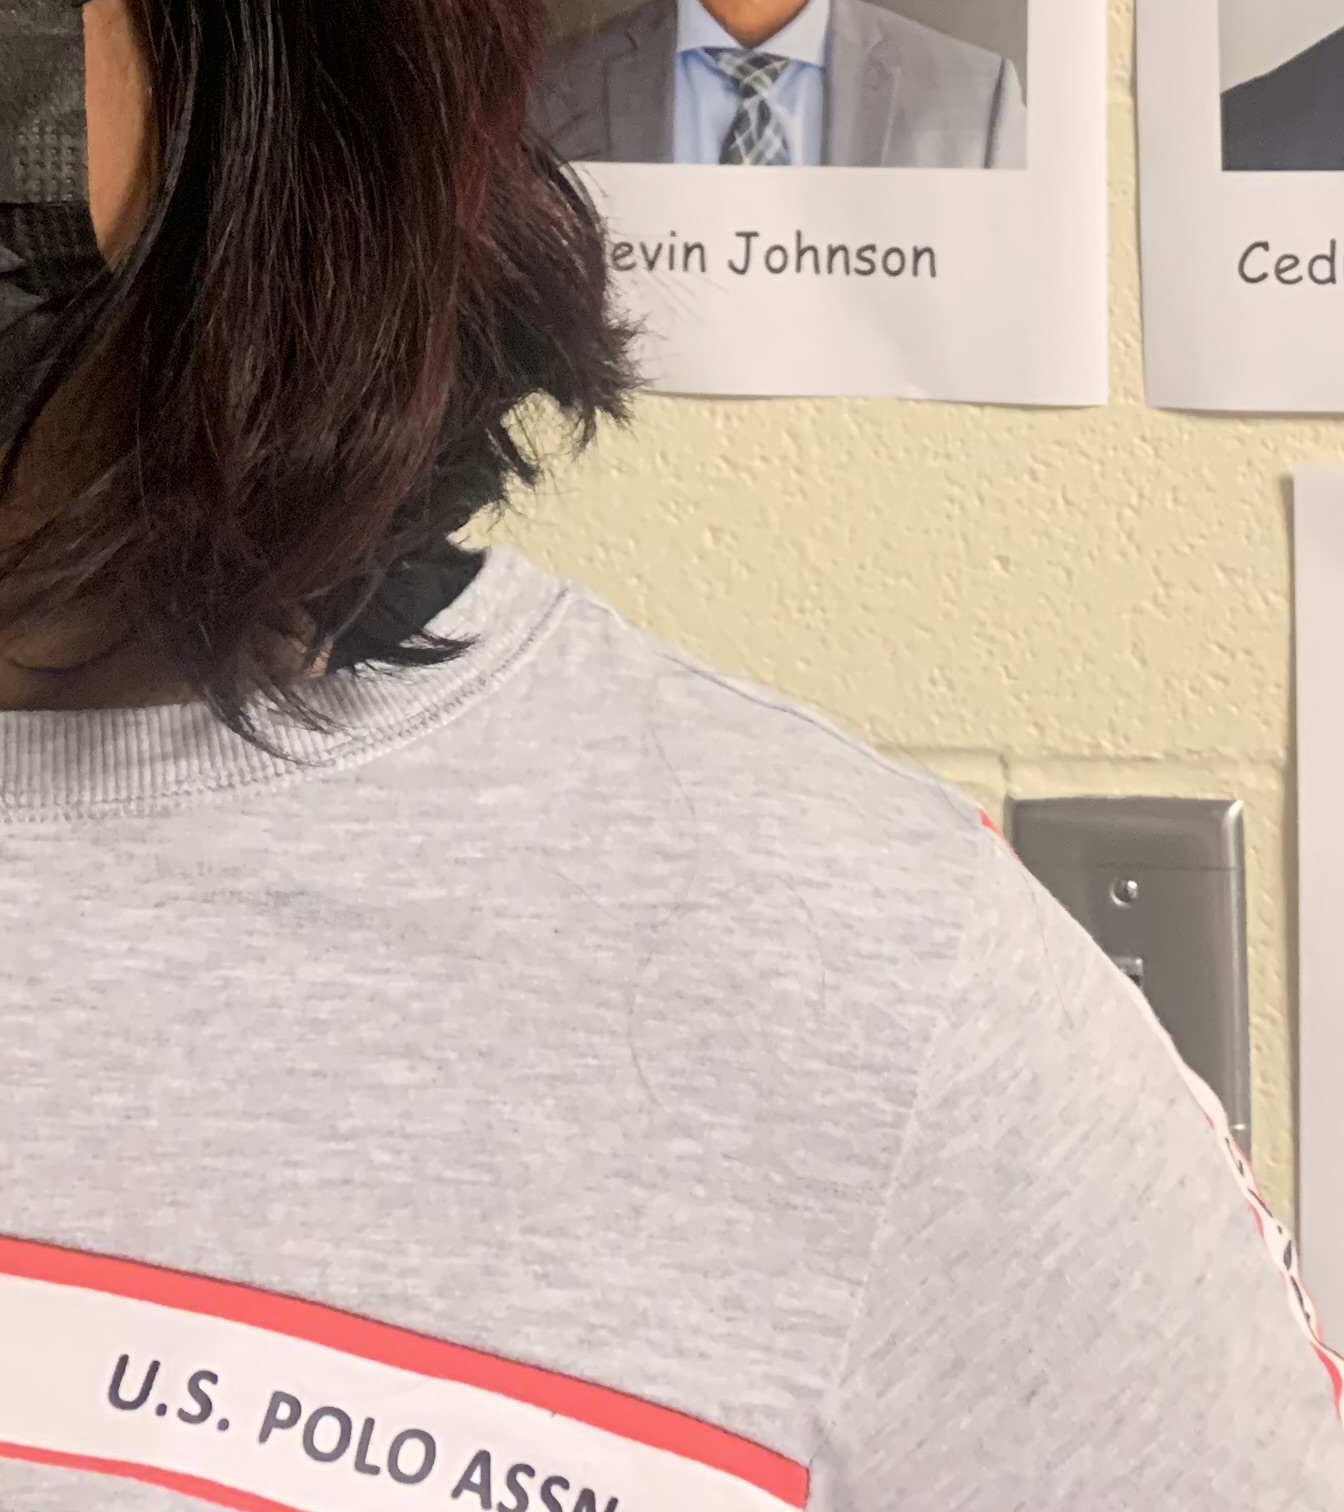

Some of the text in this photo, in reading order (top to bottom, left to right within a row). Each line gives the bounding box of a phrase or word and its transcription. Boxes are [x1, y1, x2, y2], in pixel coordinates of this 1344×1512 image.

[610, 229, 937, 278] evin Johnson
[105, 1353, 231, 1433] U.S.
[258, 1390, 437, 1486] POLO
